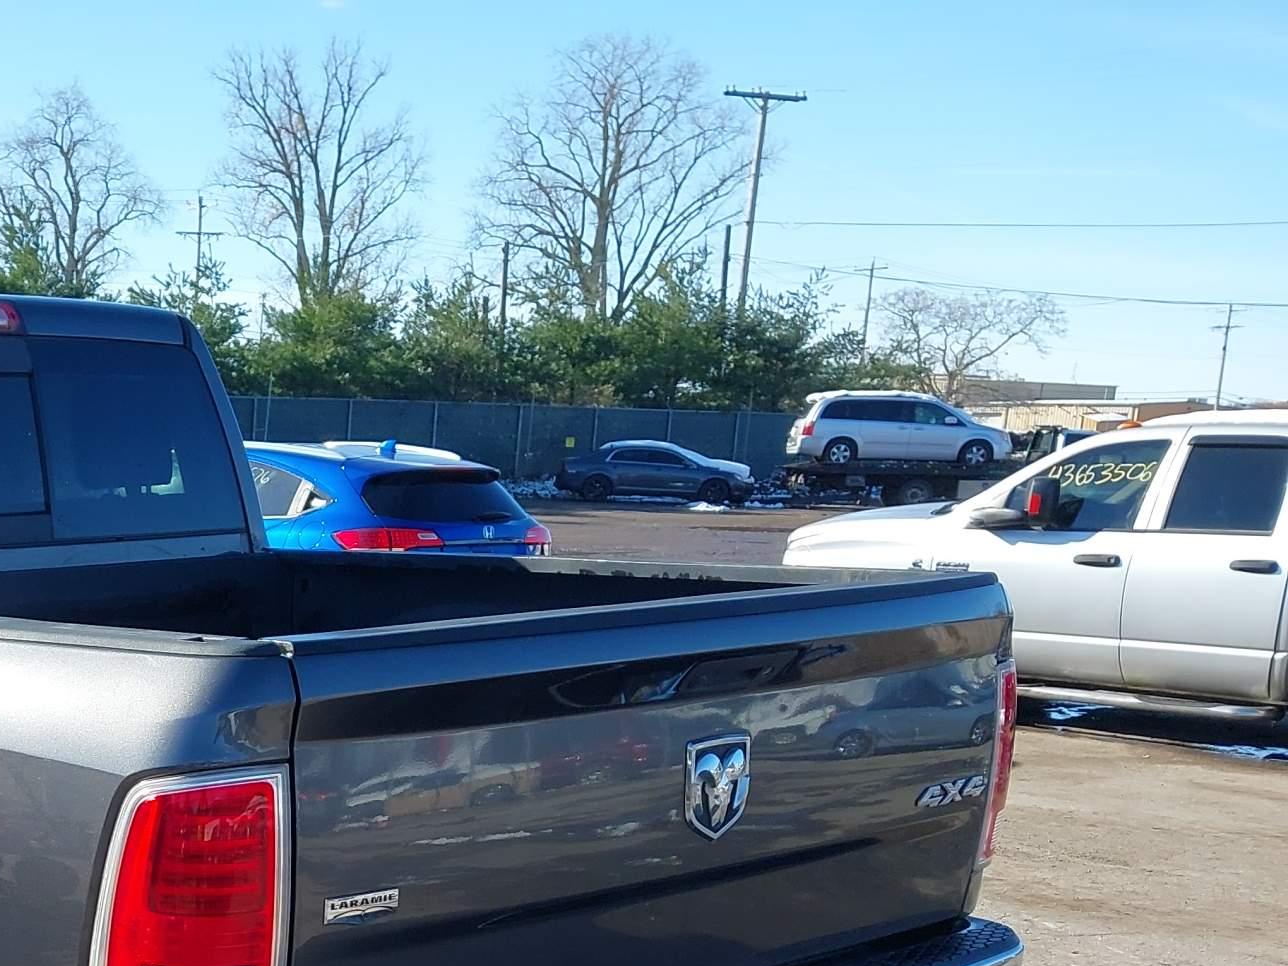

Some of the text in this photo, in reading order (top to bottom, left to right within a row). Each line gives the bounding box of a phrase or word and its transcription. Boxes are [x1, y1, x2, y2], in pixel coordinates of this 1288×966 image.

[1048, 461, 1158, 488] 43653506
[915, 775, 986, 808] 4X4
[330, 893, 397, 911] LARAMIE
